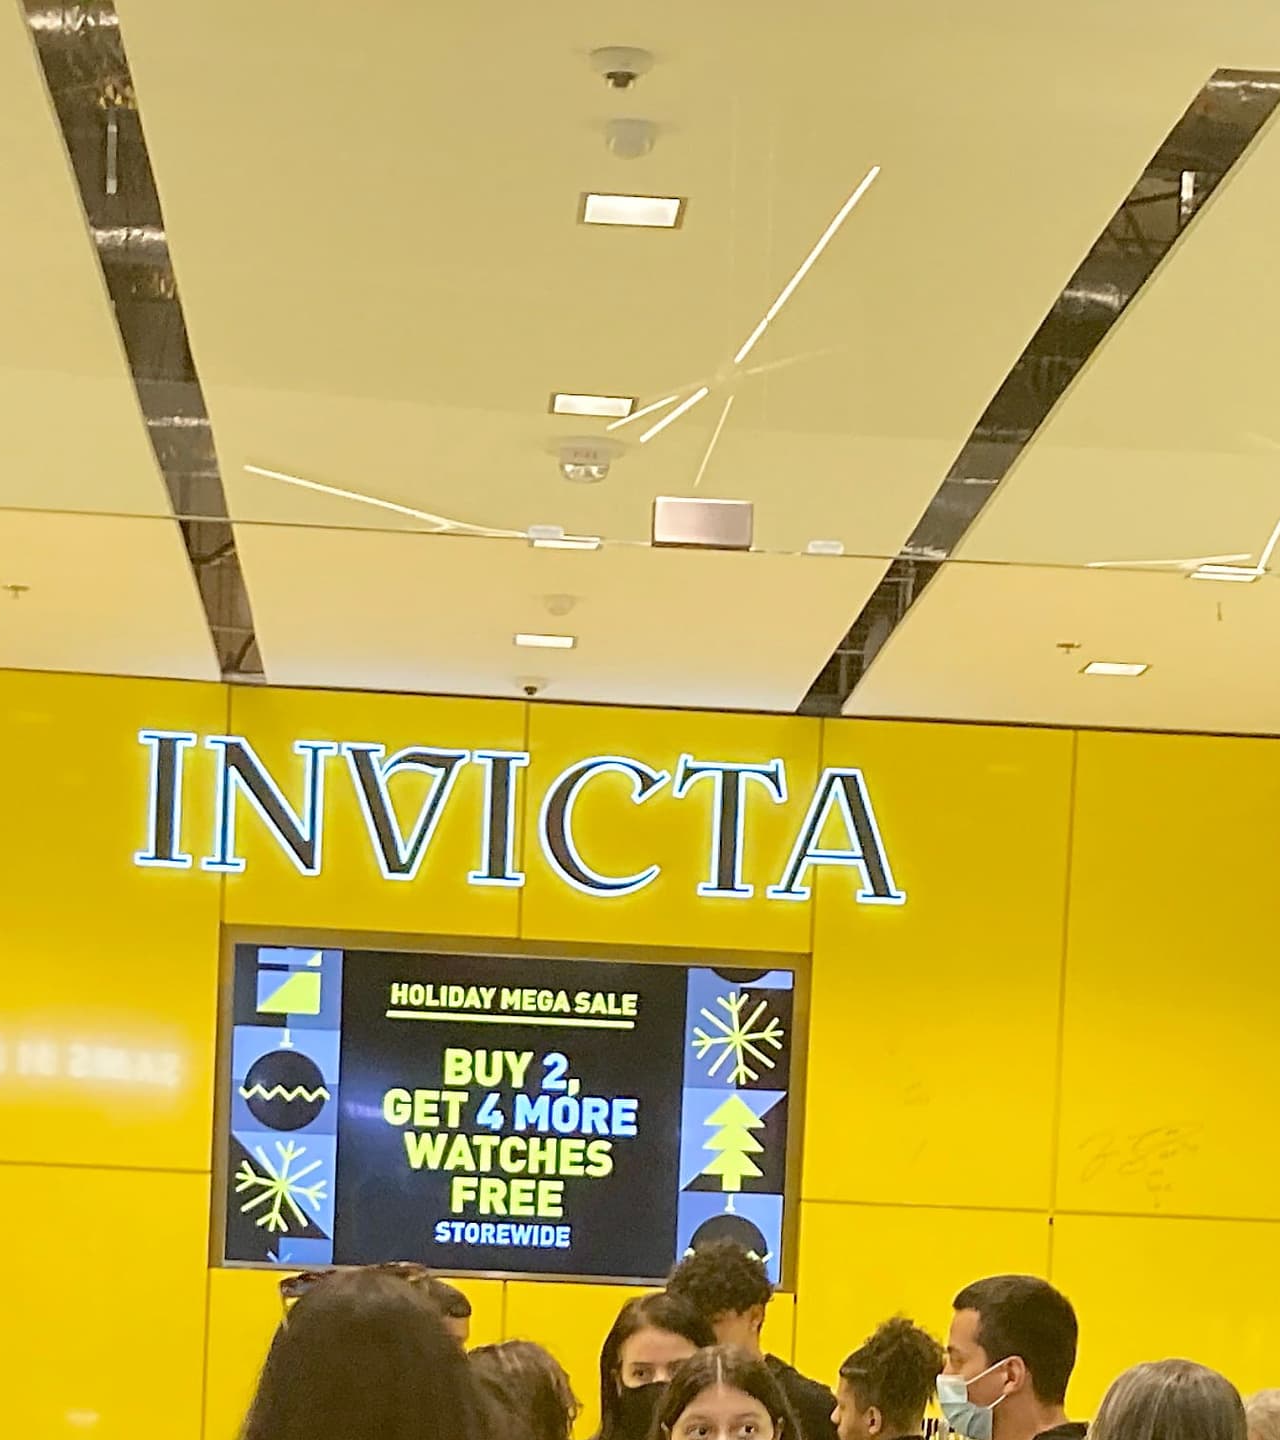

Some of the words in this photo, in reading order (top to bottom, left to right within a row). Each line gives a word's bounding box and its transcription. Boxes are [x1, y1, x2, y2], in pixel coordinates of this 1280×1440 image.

[133, 729, 907, 906] INVICTA
[390, 982, 497, 1010] HOLIDAY
[500, 988, 571, 1013] MEGA
[573, 990, 639, 1017] SALE
[443, 1048, 535, 1089] BUY
[541, 1052, 581, 1098] 2,
[382, 1088, 469, 1127] GET
[476, 1092, 505, 1131] 4
[515, 1094, 639, 1137] MORE
[403, 1131, 614, 1178] WATCHES
[450, 1175, 565, 1218] FREE
[433, 1220, 572, 1249] STOREWIDE
